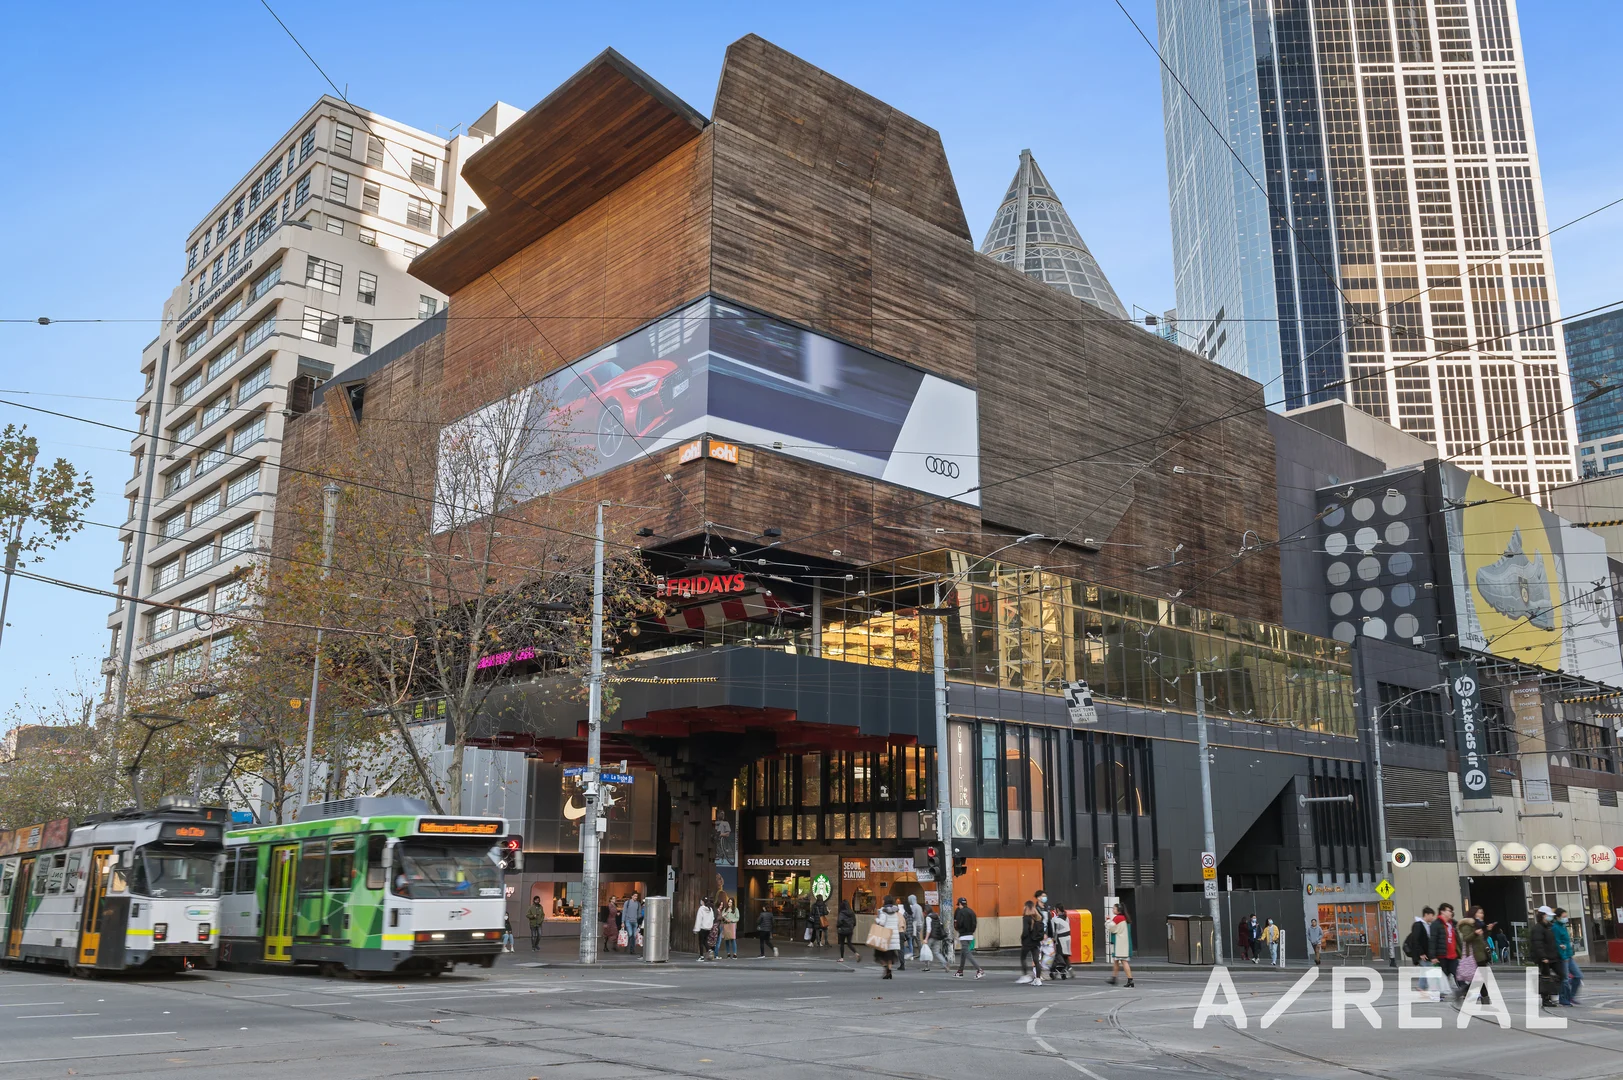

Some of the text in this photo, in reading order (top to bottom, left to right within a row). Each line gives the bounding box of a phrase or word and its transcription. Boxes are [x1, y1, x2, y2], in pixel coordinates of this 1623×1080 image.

[666, 573, 746, 597] FRIDAYS
[1461, 698, 1477, 750] SPORTS
[1468, 775, 1484, 785] JD
[747, 858, 810, 866] STARBUCKS COFFEE
[843, 861, 862, 870] SEOUL
[1204, 857, 1212, 865] 30
[668, 871, 674, 880] 1
[843, 870, 866, 879] STATION
